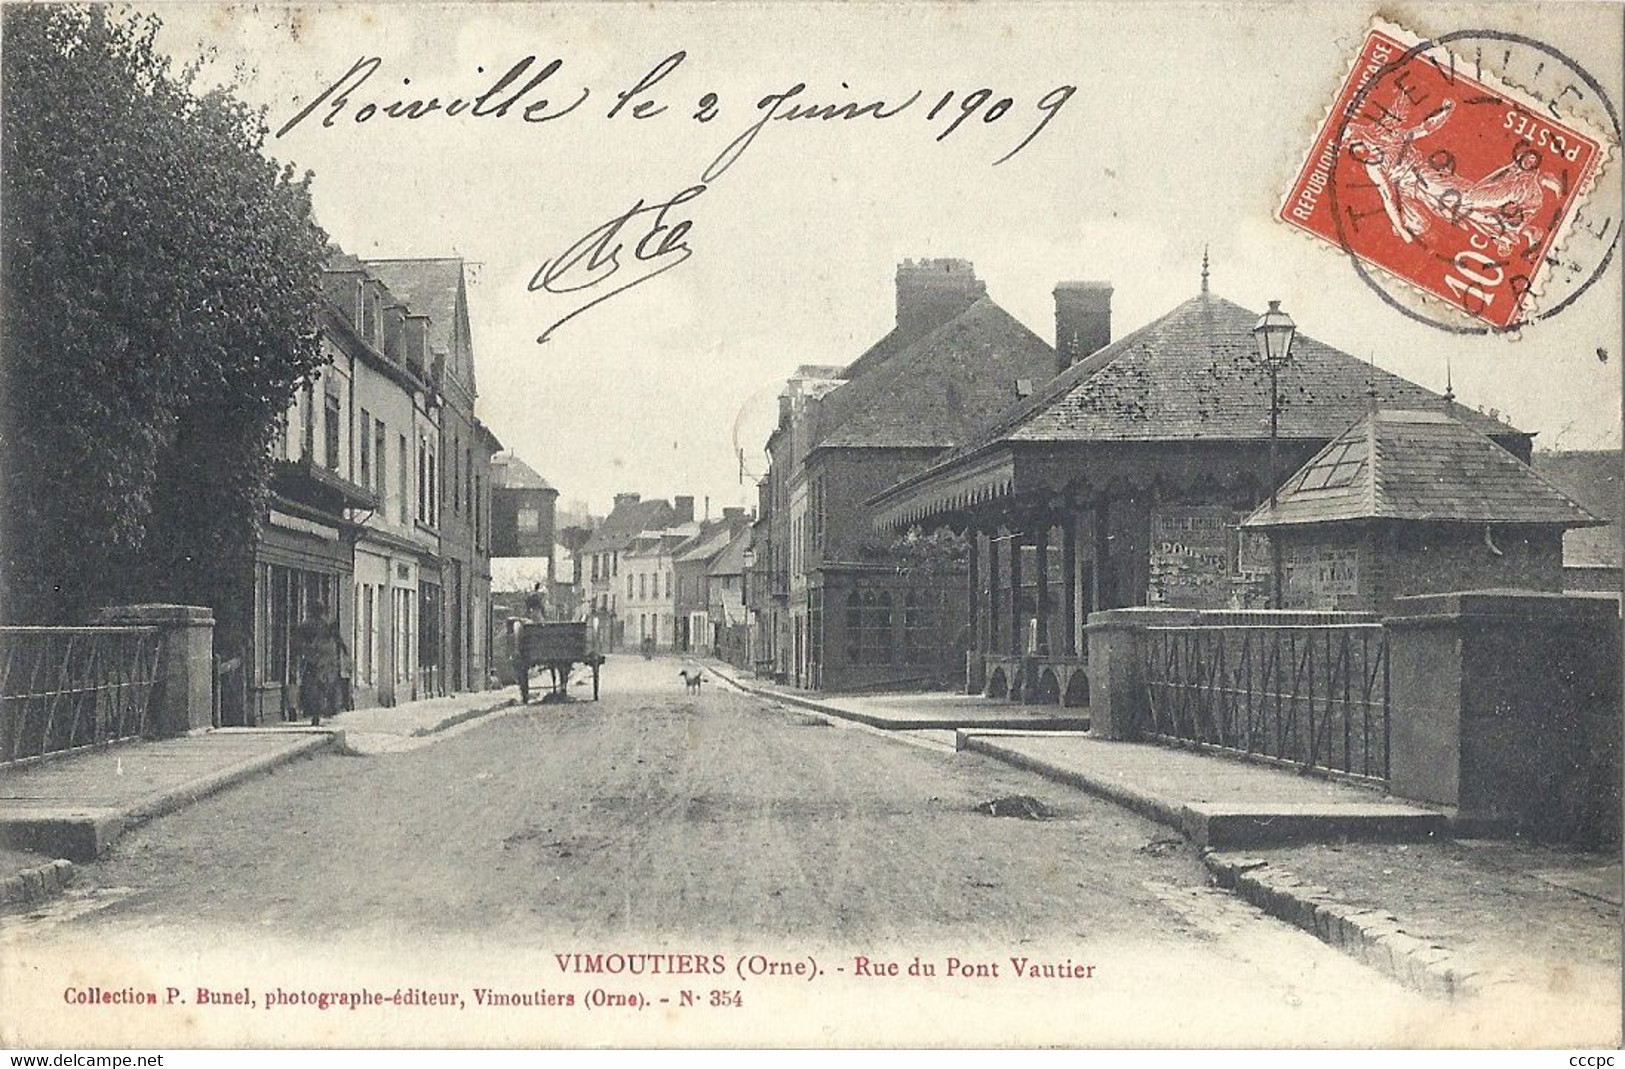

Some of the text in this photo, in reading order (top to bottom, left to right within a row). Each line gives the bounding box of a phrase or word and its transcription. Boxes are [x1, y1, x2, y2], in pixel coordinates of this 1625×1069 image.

[607, 50, 687, 120] le
[692, 92, 720, 123] 2
[926, 85, 1078, 167] 1909
[1503, 110, 1581, 163] POSTES
